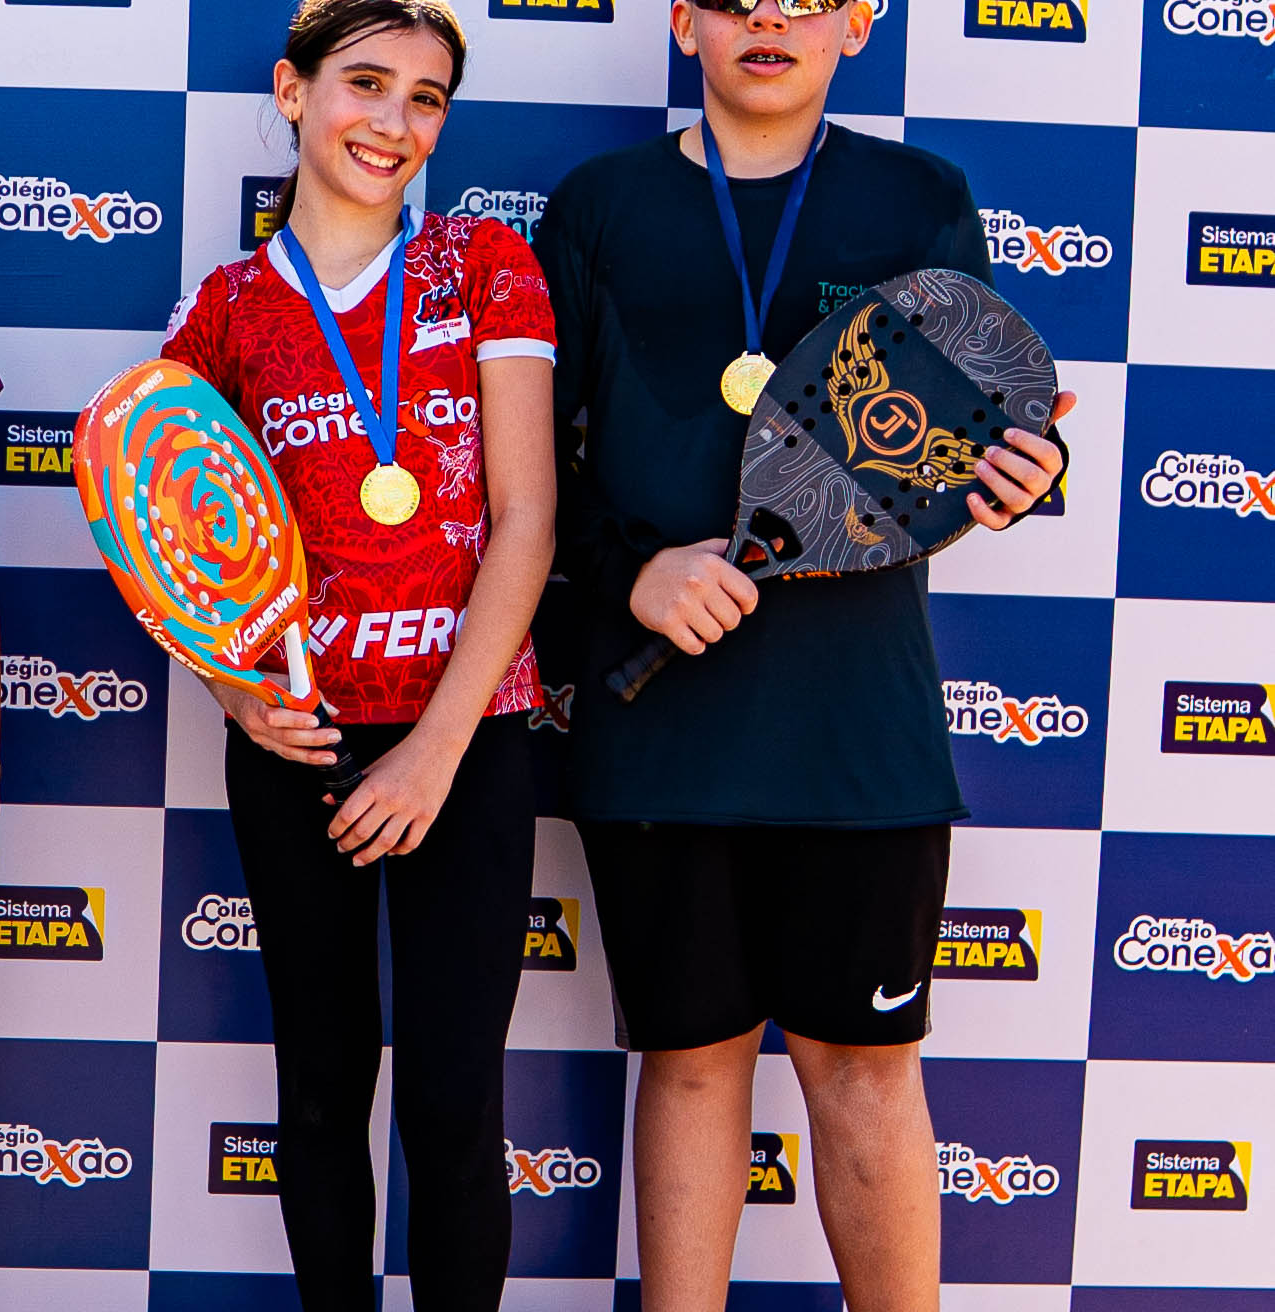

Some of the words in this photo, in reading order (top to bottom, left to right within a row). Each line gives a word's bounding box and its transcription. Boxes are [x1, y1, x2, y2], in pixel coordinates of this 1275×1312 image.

[978, 0, 1073, 29] ETAPA
[980, 214, 1020, 234] égio
[1201, 226, 1275, 245] Sistema
[988, 228, 1108, 271] neXão
[1200, 247, 1275, 274] ETAP
[103, 399, 134, 428] BEACH
[133, 369, 165, 401] TENNIS
[263, 389, 374, 426] Colég
[7, 424, 74, 445] Sistem
[6, 446, 73, 473] ETAP
[1161, 455, 1240, 479] Colégio
[1145, 471, 1275, 515] ConeX
[243, 582, 300, 646] CAMEWIN
[0, 658, 53, 679] légio
[0, 673, 144, 717] neXão
[945, 682, 998, 706] légio
[1177, 694, 1251, 714] Sistema
[946, 700, 1085, 741] neXão
[1175, 716, 1267, 744] ETAPA
[201, 899, 251, 922] Colé
[937, 920, 1010, 939] Sistema
[1133, 919, 1212, 944] Colégio
[933, 941, 1026, 968] ETAPA
[1119, 936, 1275, 979] ConeXã
[224, 1136, 277, 1155] Siste
[223, 1156, 278, 1182] ETA
[1147, 1152, 1221, 1172] Sistema
[939, 1159, 1056, 1201] neXão
[1144, 1173, 1235, 1199] ETAPA
